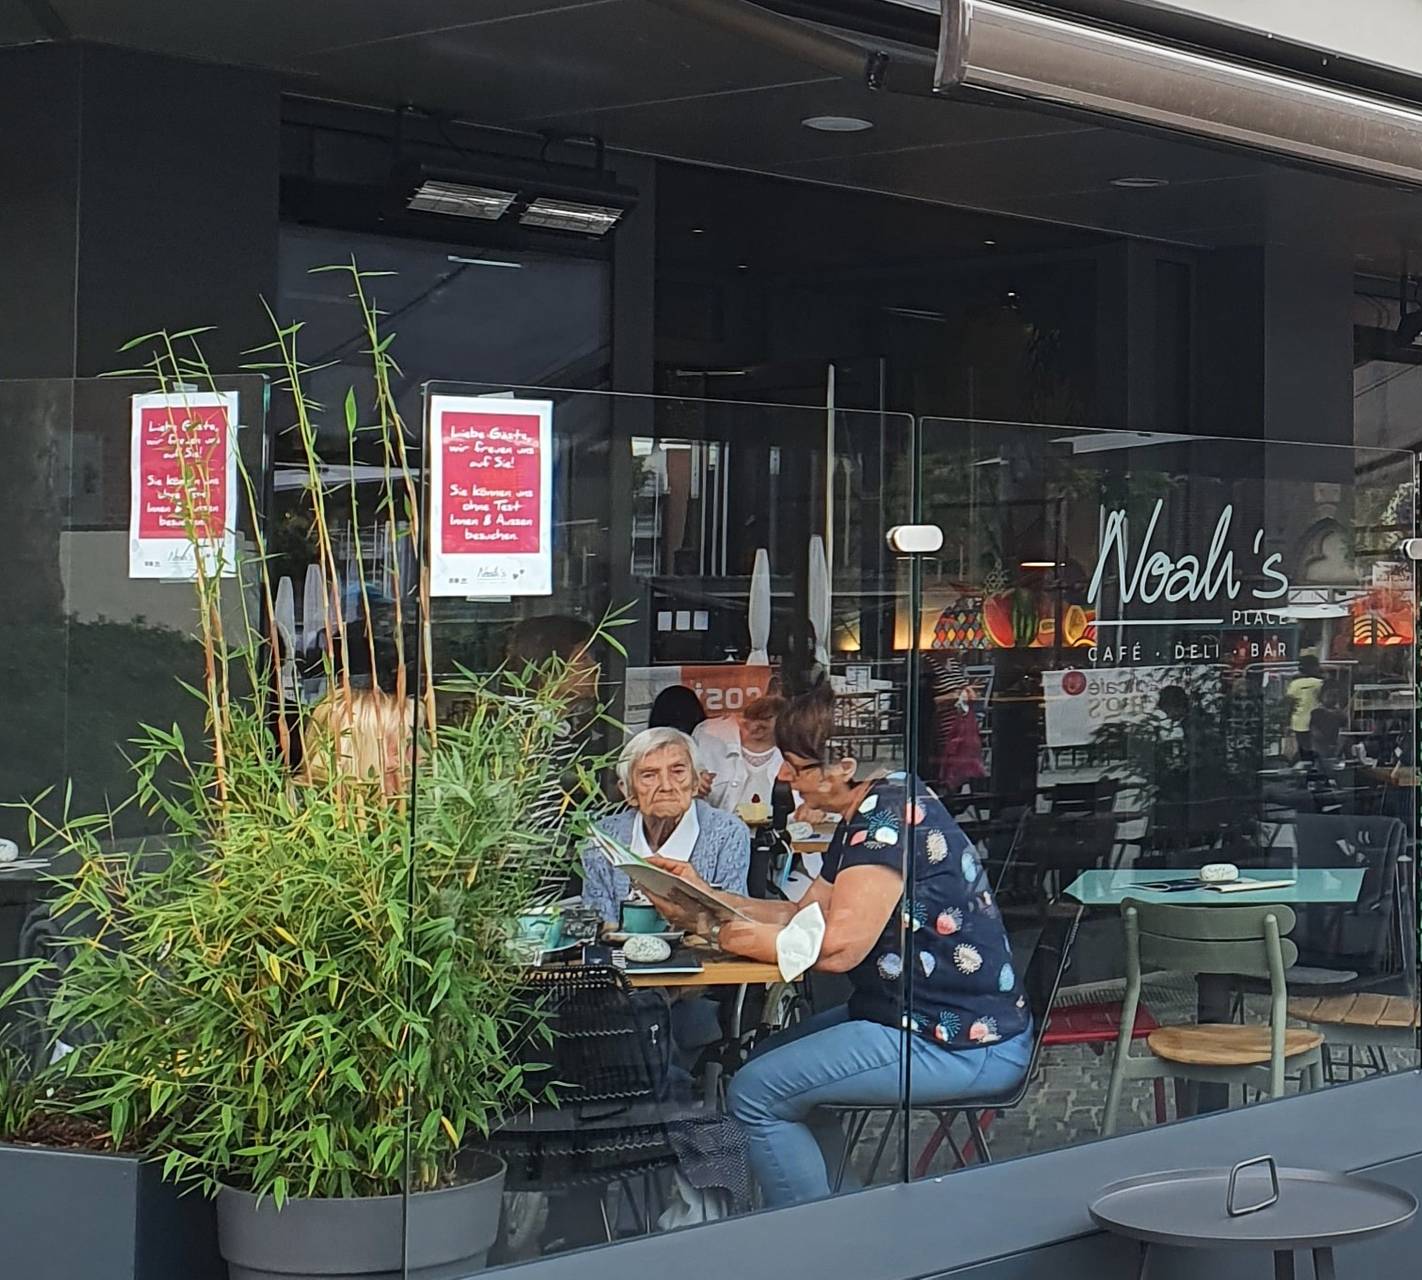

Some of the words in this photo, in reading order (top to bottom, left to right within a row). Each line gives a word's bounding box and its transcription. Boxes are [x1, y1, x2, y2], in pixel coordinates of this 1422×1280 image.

[450, 485, 468, 496] Sie
[493, 500, 523, 511] Test
[1087, 498, 1288, 604] Noah's
[1232, 610, 1288, 625] PLACE
[1087, 642, 1142, 662] CAFÉ
[1174, 643, 1219, 660] DELI
[1250, 642, 1287, 658] BAR
